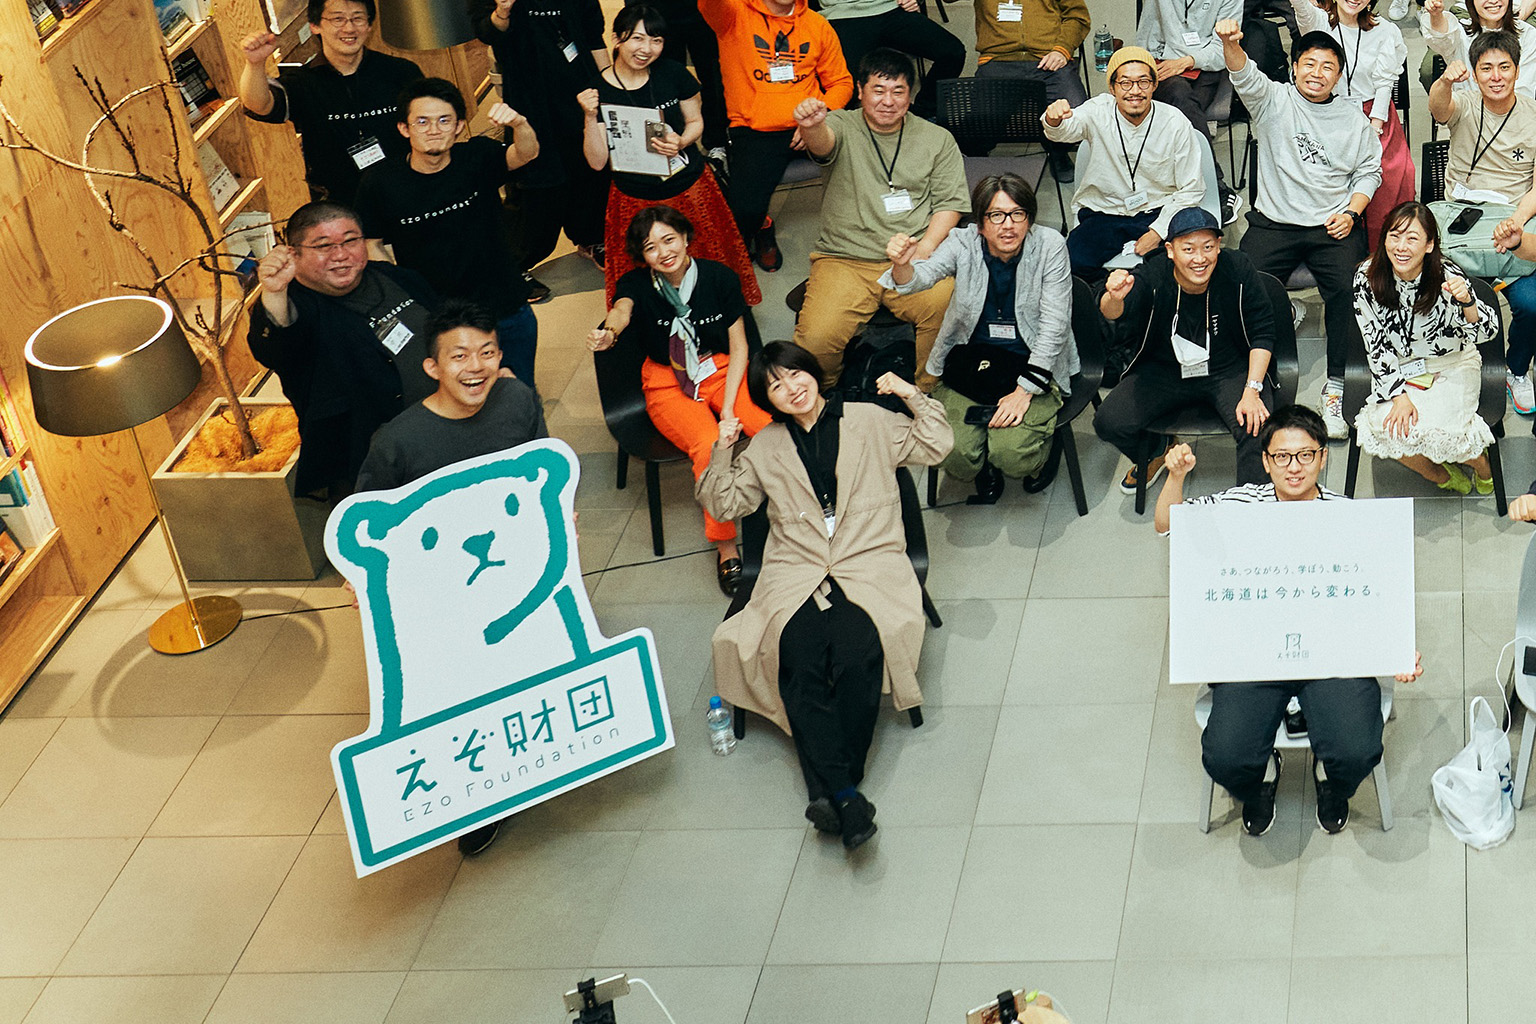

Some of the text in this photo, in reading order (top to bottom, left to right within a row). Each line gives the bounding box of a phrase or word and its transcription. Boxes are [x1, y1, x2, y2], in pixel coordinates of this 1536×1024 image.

[396, 675, 615, 801] えぞ財団
[466, 727, 620, 798] Foundation
